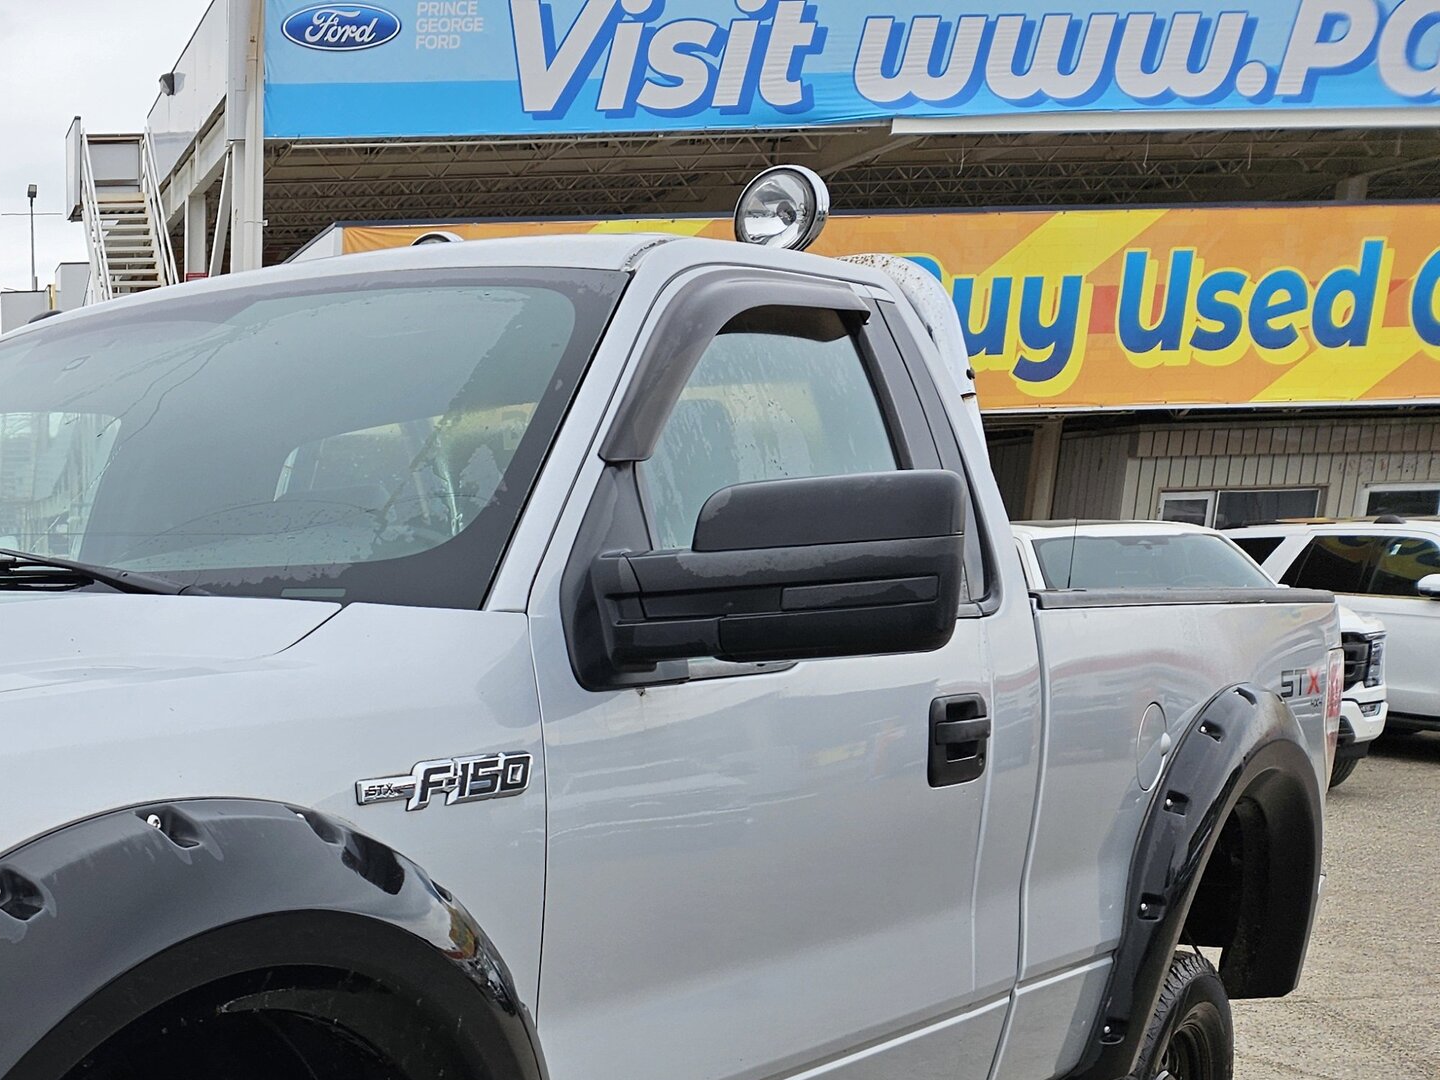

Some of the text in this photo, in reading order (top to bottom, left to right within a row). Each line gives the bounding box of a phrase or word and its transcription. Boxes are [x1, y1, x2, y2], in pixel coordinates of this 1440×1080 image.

[416, 1, 478, 17] PRINCE
[416, 17, 483, 33] GEORGE
[304, 9, 378, 44] Ford
[416, 34, 460, 50] FORD
[509, 0, 817, 113] Visit
[1117, 239, 1386, 352] Used
[1281, 667, 1320, 697] STX
[407, 751, 533, 810] F-150
